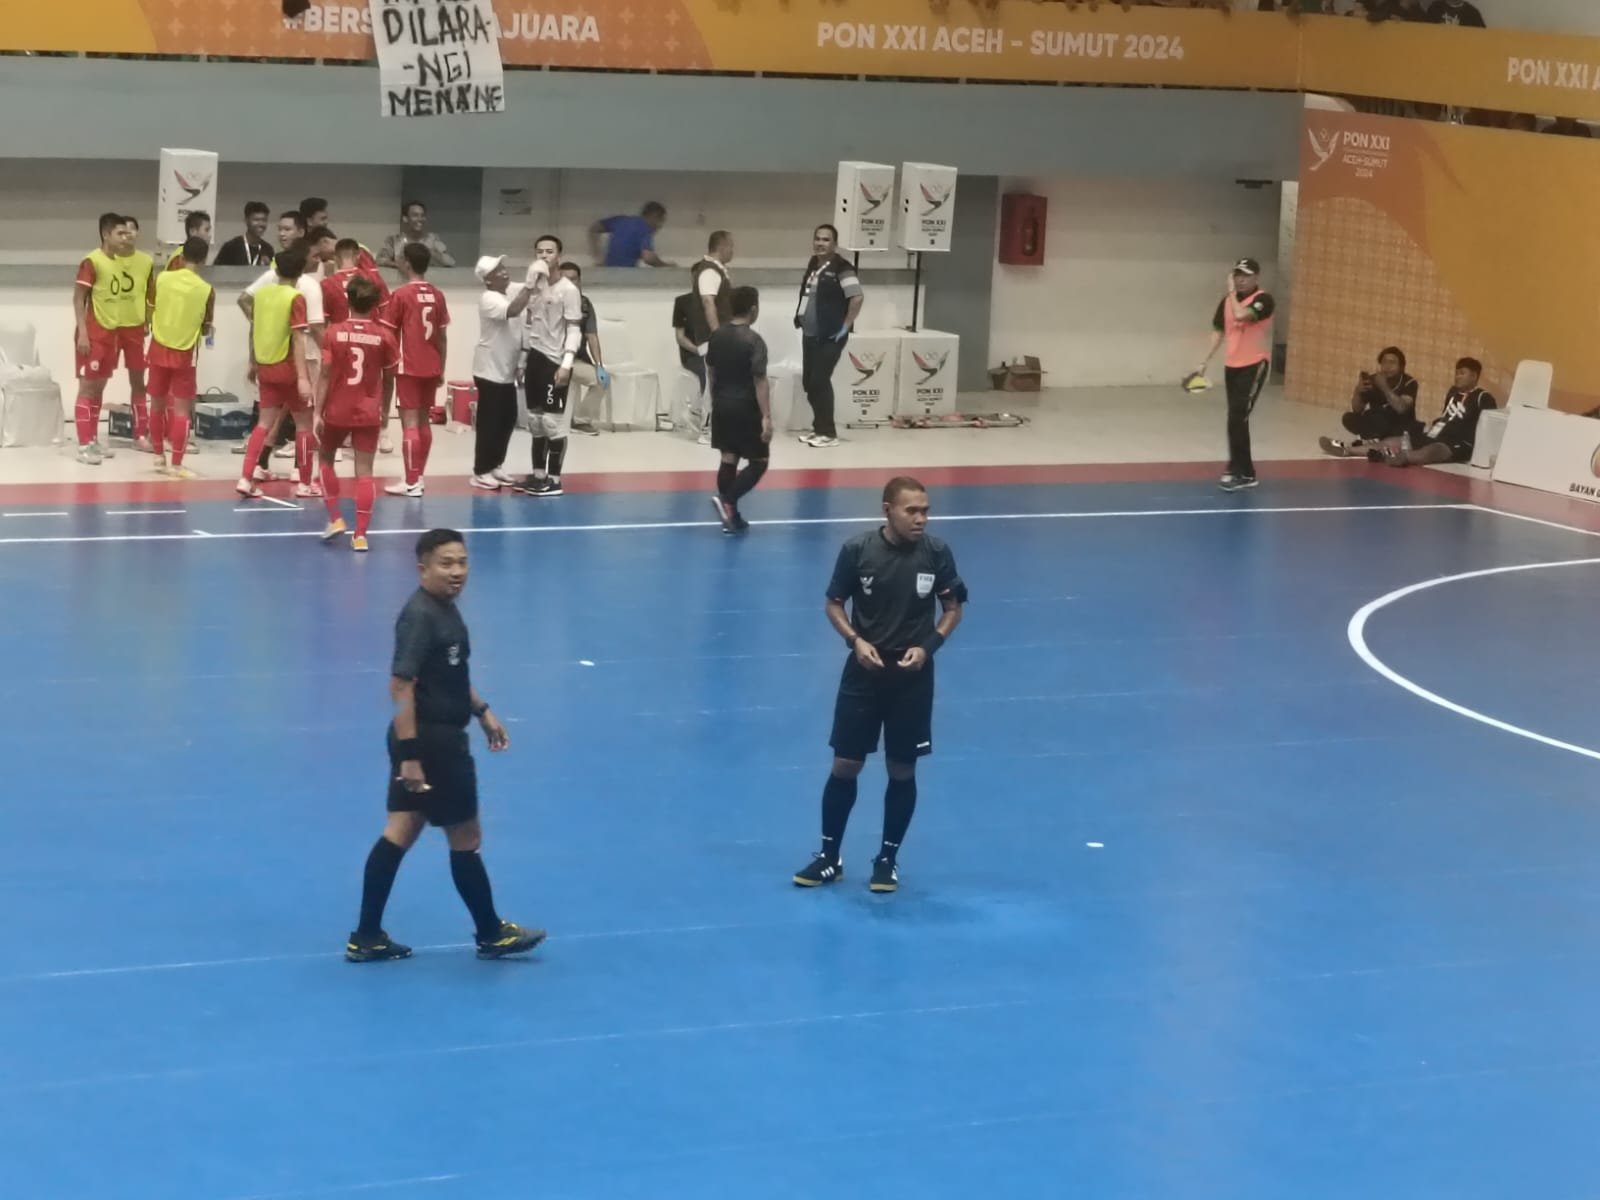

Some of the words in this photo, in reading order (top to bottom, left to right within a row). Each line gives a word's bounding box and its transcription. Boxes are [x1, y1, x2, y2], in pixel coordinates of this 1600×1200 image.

[817, 22, 876, 48] PON
[882, 24, 927, 50] XXI
[932, 26, 1003, 53] ACEH
[1030, 30, 1119, 57] SUMUT
[1124, 34, 1185, 60] 2024
[1507, 57, 1550, 85] PON
[1553, 61, 1588, 89] XXI
[1343, 131, 1369, 148] PON
[1370, 134, 1390, 150] XXI
[422, 306, 433, 341] 5
[347, 346, 365, 385] 3
